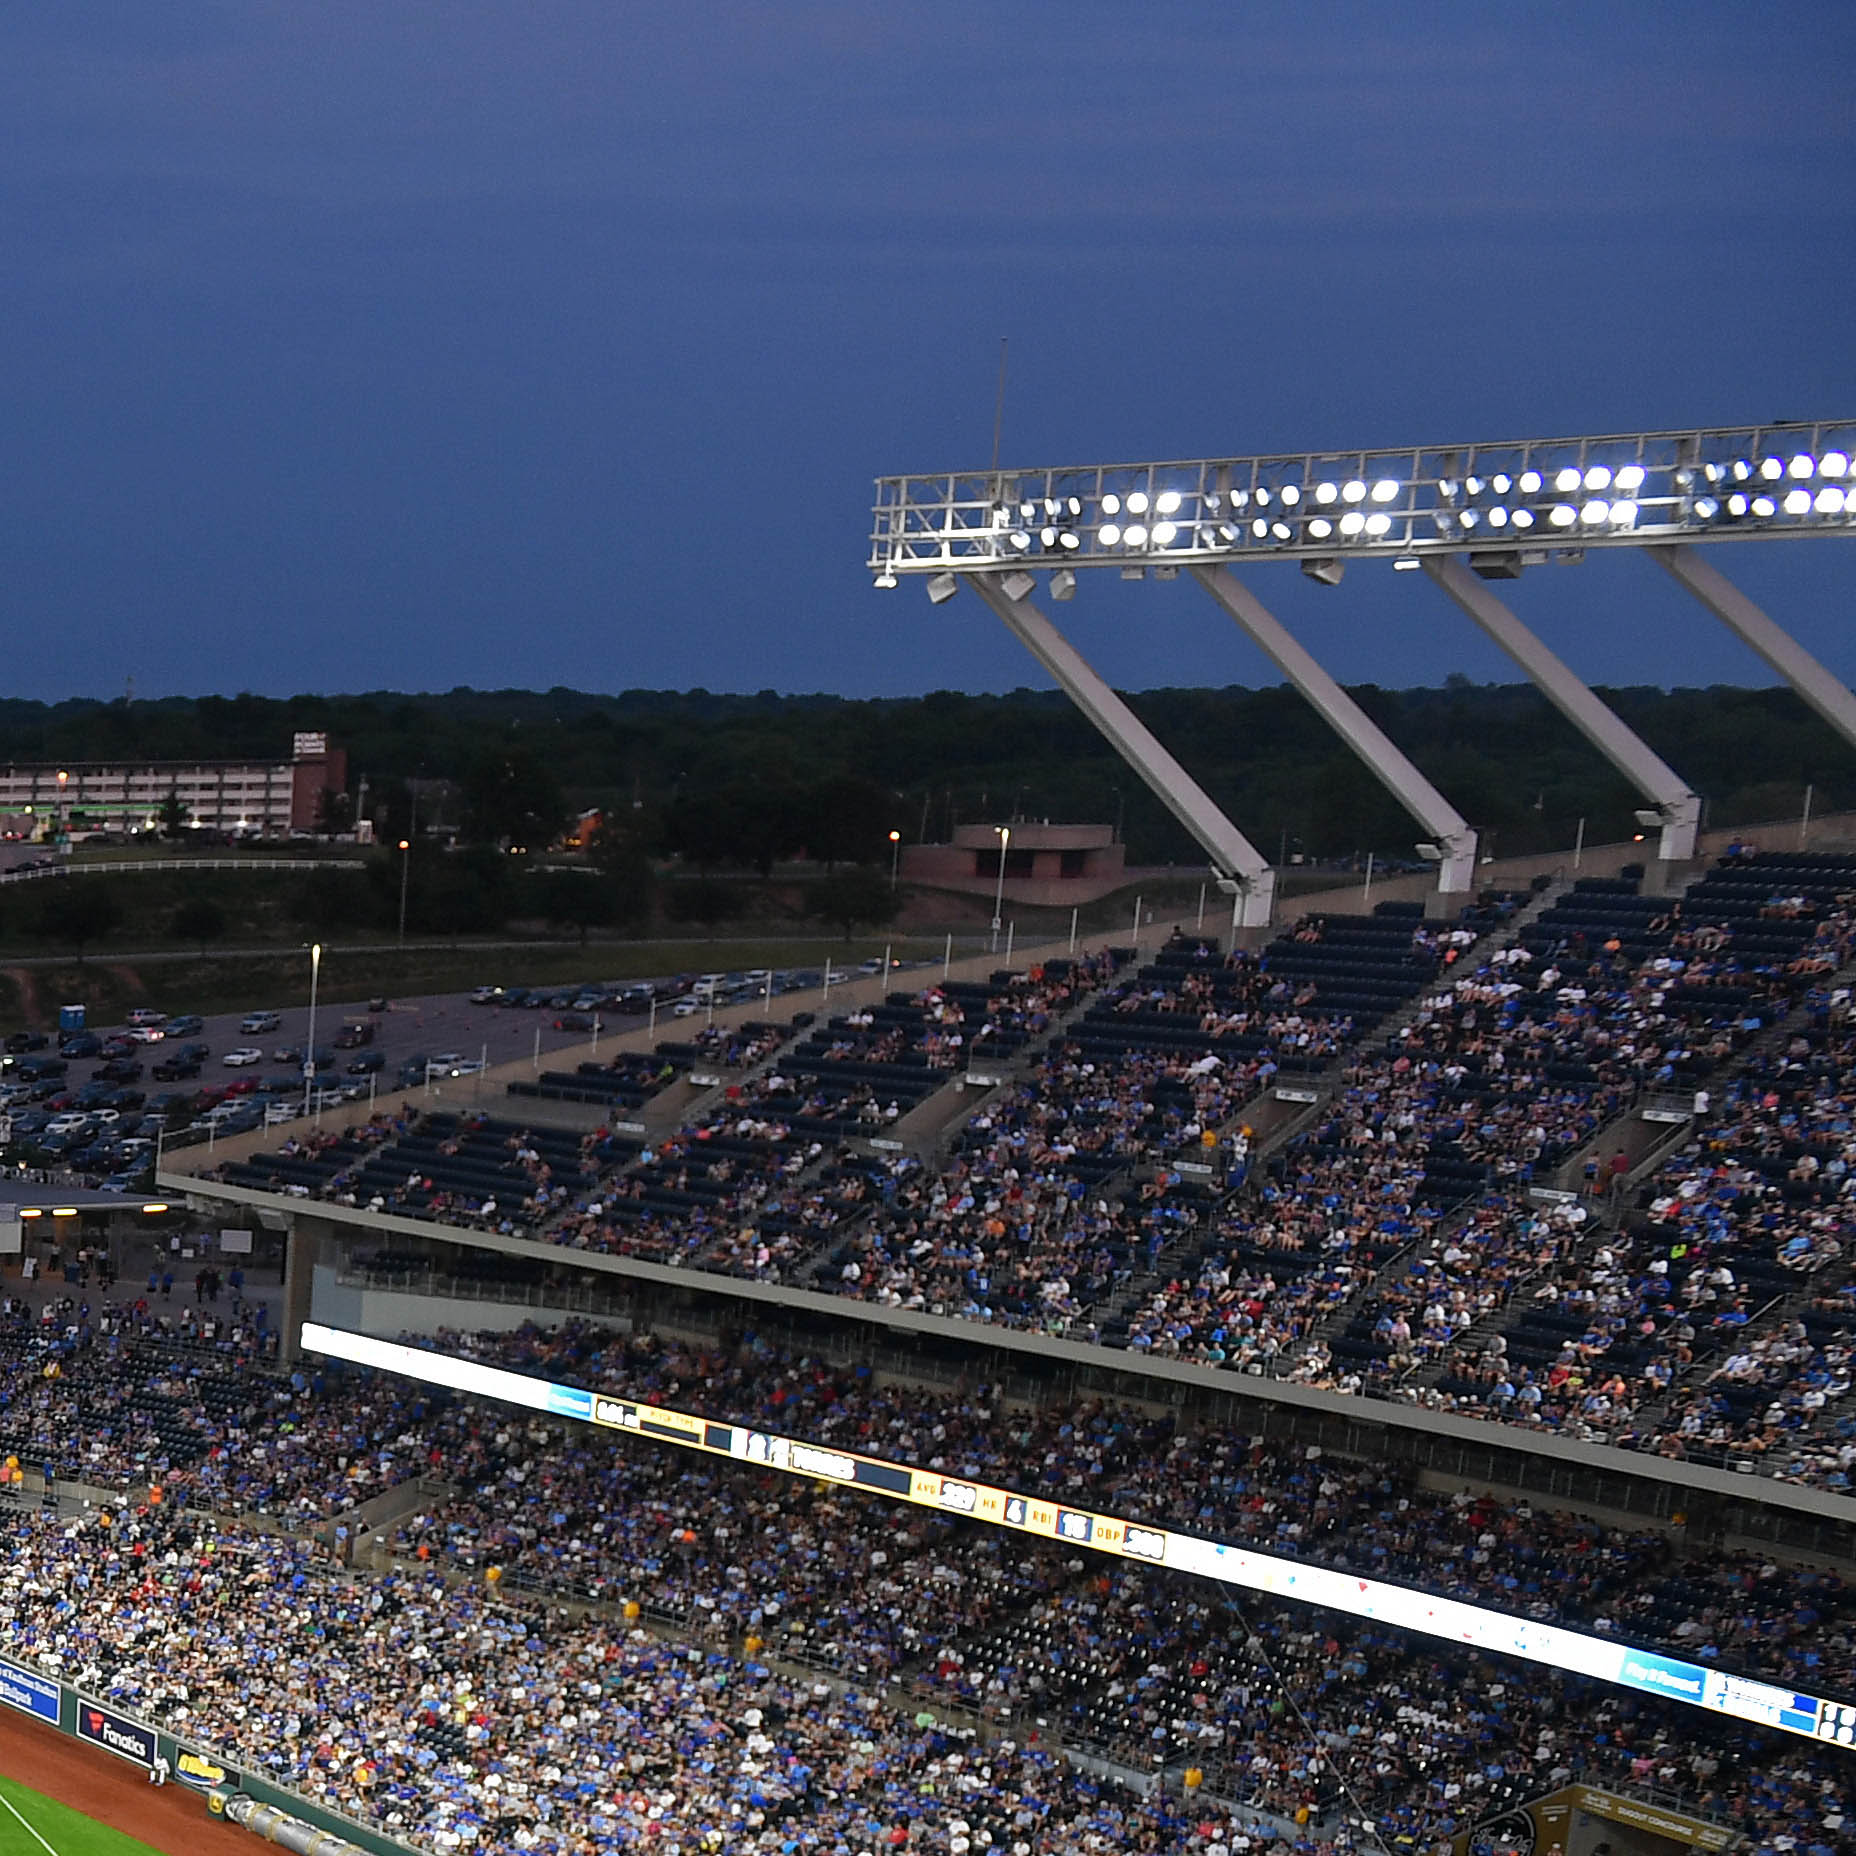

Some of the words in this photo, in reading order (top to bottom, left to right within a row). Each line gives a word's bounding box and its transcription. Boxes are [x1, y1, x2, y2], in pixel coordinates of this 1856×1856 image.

[916, 1482, 936, 1495] AVG
[982, 1499, 998, 1511] HR
[1033, 1511, 1051, 1526] RBI
[1096, 1527, 1122, 1541] OBP
[103, 1722, 146, 1758] Fanatics
